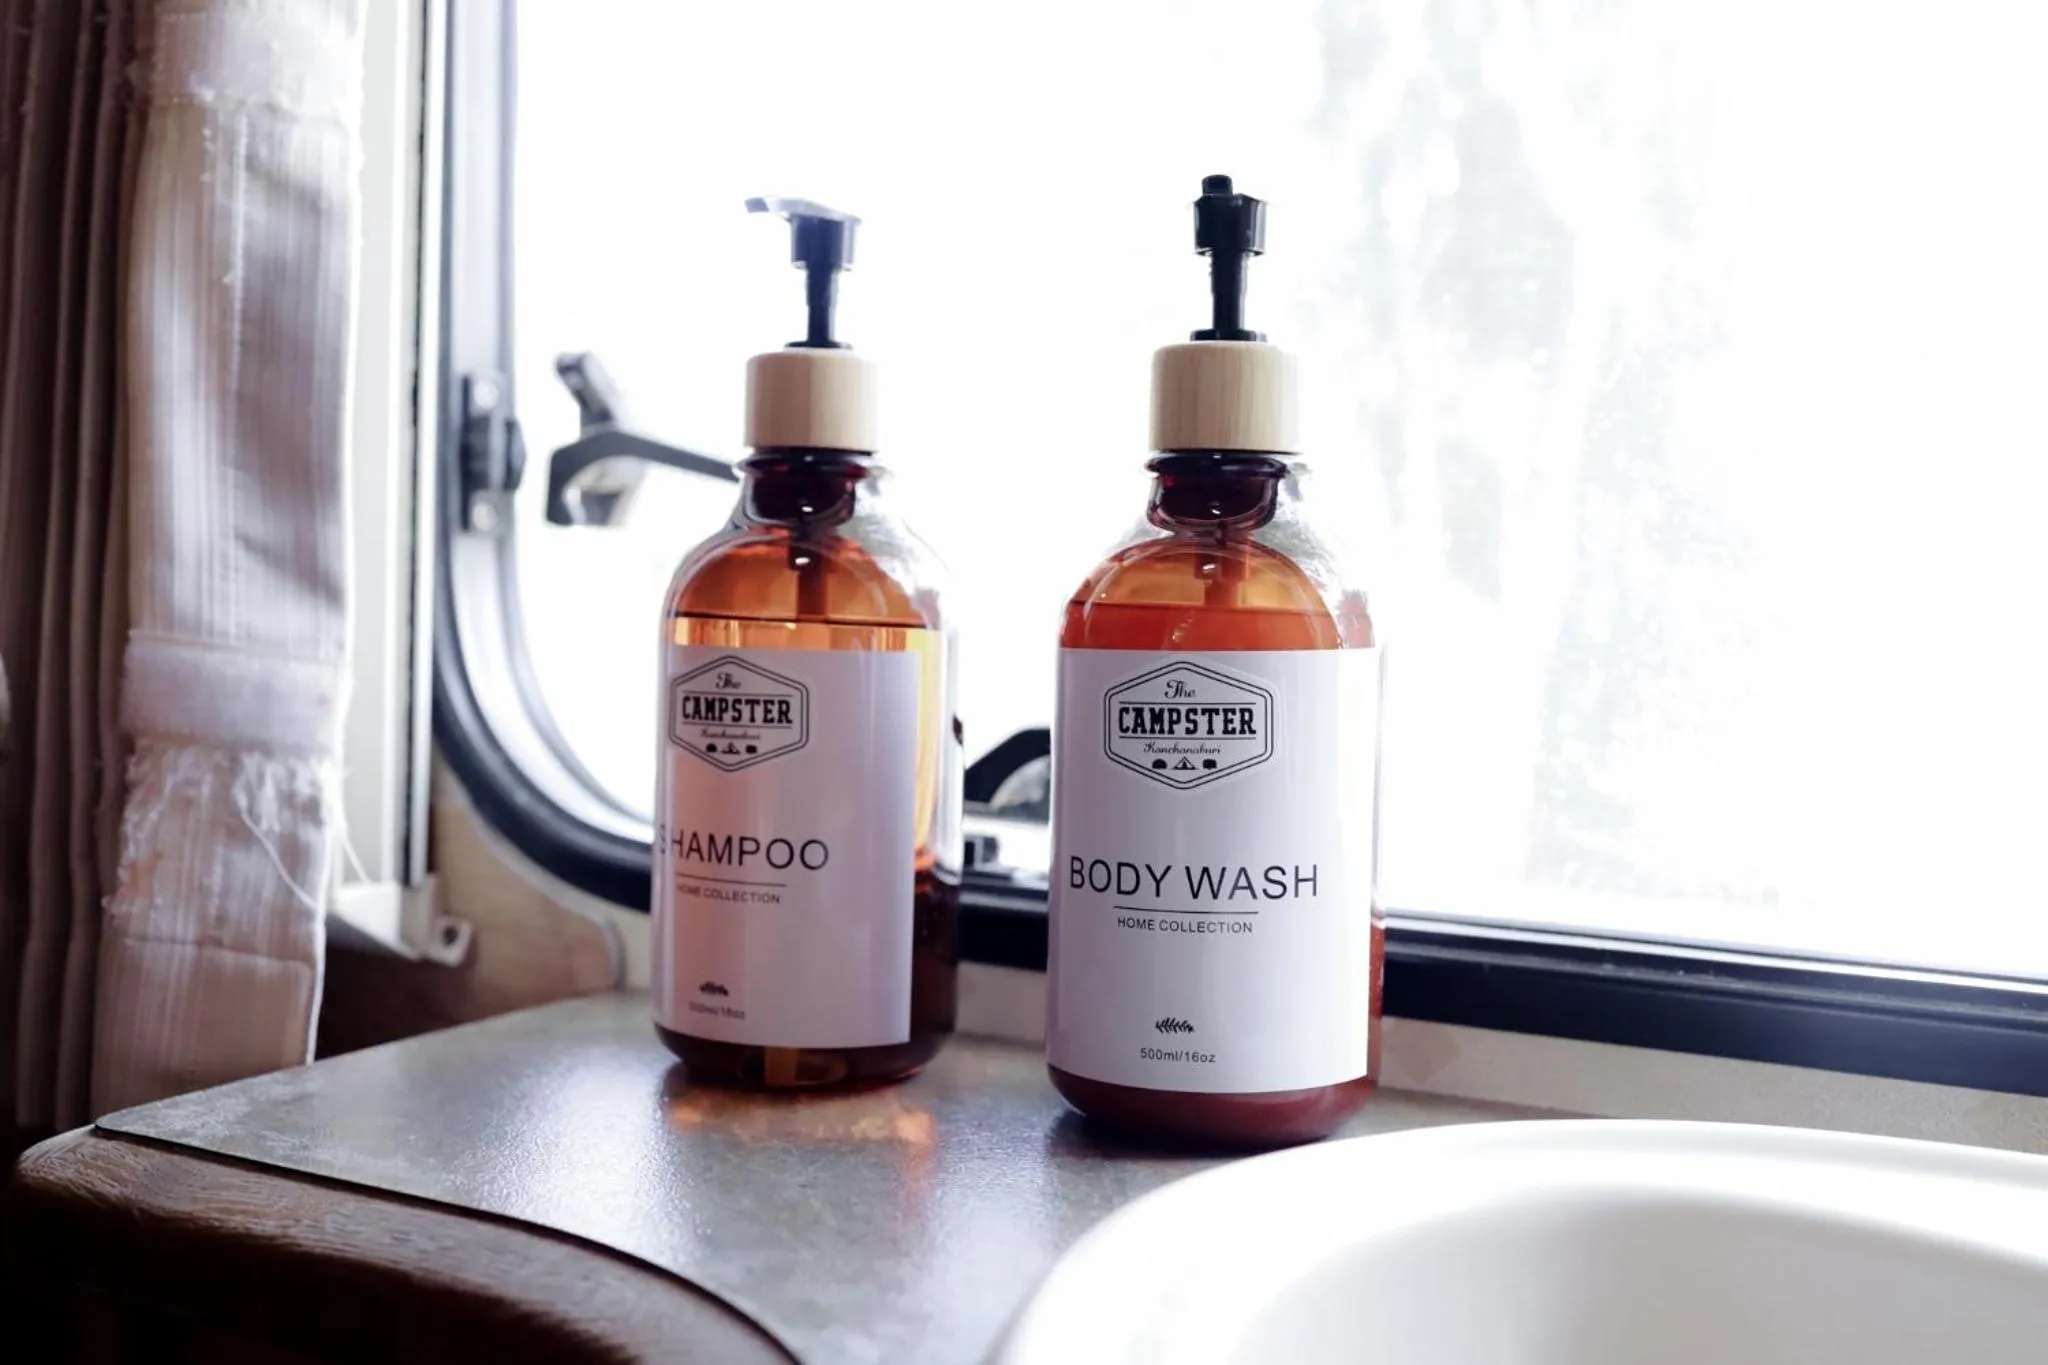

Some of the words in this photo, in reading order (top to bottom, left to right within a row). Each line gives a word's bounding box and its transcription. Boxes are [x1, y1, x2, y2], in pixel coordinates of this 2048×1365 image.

[1164, 679, 1196, 699] The
[682, 695, 793, 724] CAMPSTER
[1118, 706, 1257, 735] CAMPSTER
[1143, 741, 1222, 755] Kanchanaburi
[1070, 856, 1172, 898] BODY
[1185, 864, 1318, 900] WASH
[703, 887, 780, 904] COLLECTION
[1117, 917, 1155, 931] HOME
[1159, 919, 1253, 933] COLLECTION
[1140, 1047, 1216, 1063] 500ml/16oz
